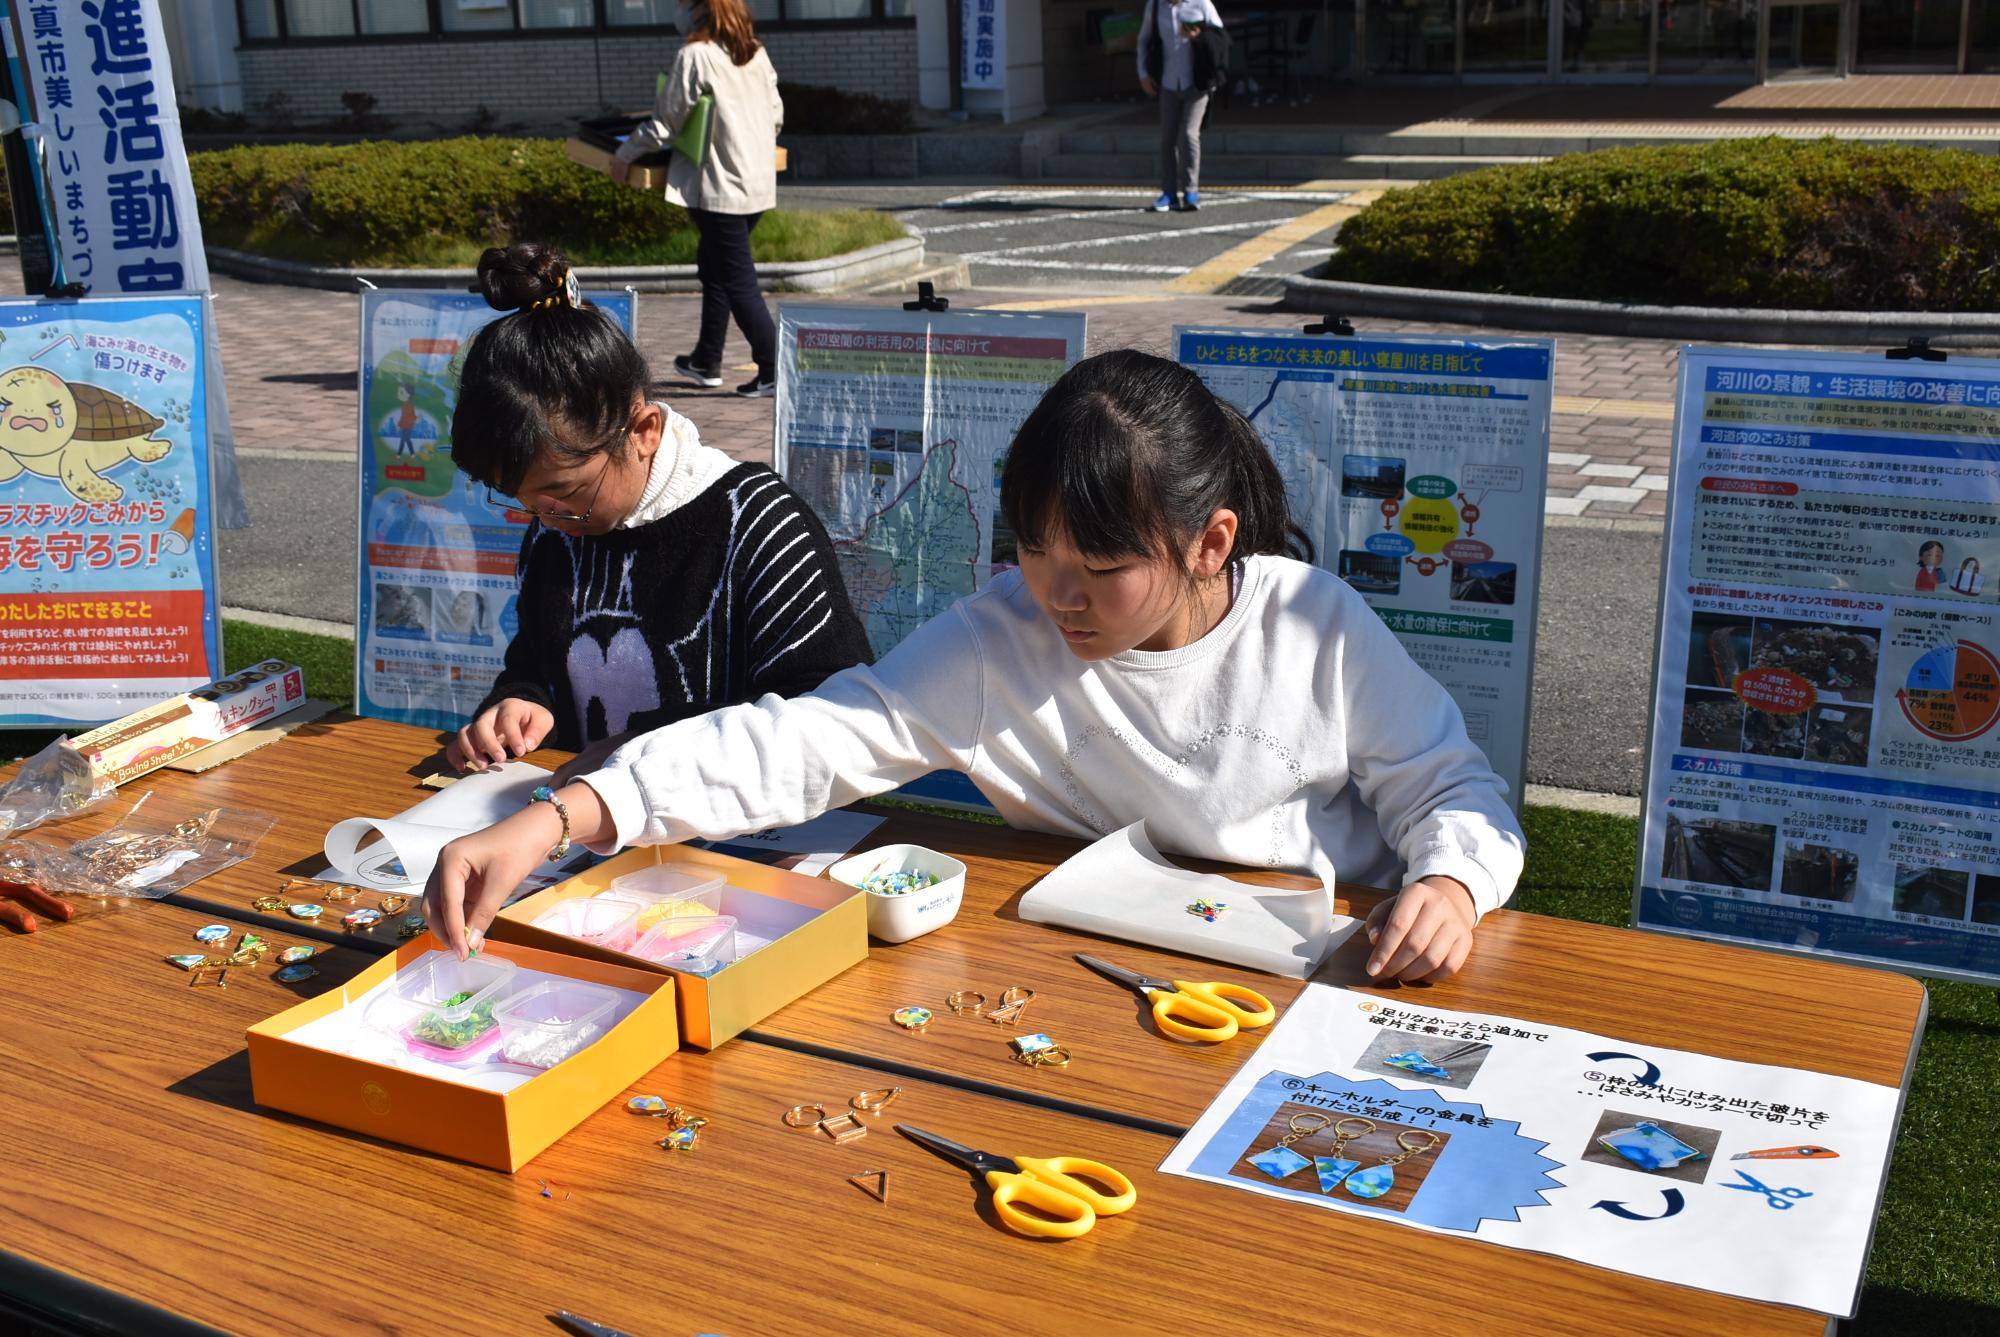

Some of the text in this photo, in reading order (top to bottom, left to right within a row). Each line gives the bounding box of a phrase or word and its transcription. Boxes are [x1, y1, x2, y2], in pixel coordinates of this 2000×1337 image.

[30, 0, 93, 293] 真市美しいまちづ
[94, 351, 167, 383] 傷つけます
[1716, 371, 2000, 404] 河川の景観・生活環境の改善に向
[1711, 429, 1811, 447] 河道内のごみ対策
[0, 501, 166, 525] ラスチックごみから
[1928, 720, 1953, 732] 23%
[118, 758, 149, 781] Baking
[150, 749, 175, 766] Sheet
[1682, 758, 1744, 777] スカム対策
[1368, 1015, 1492, 1042] 破片を乗せるよ
[1598, 1083, 1825, 1131] はさみやカッターで切って
